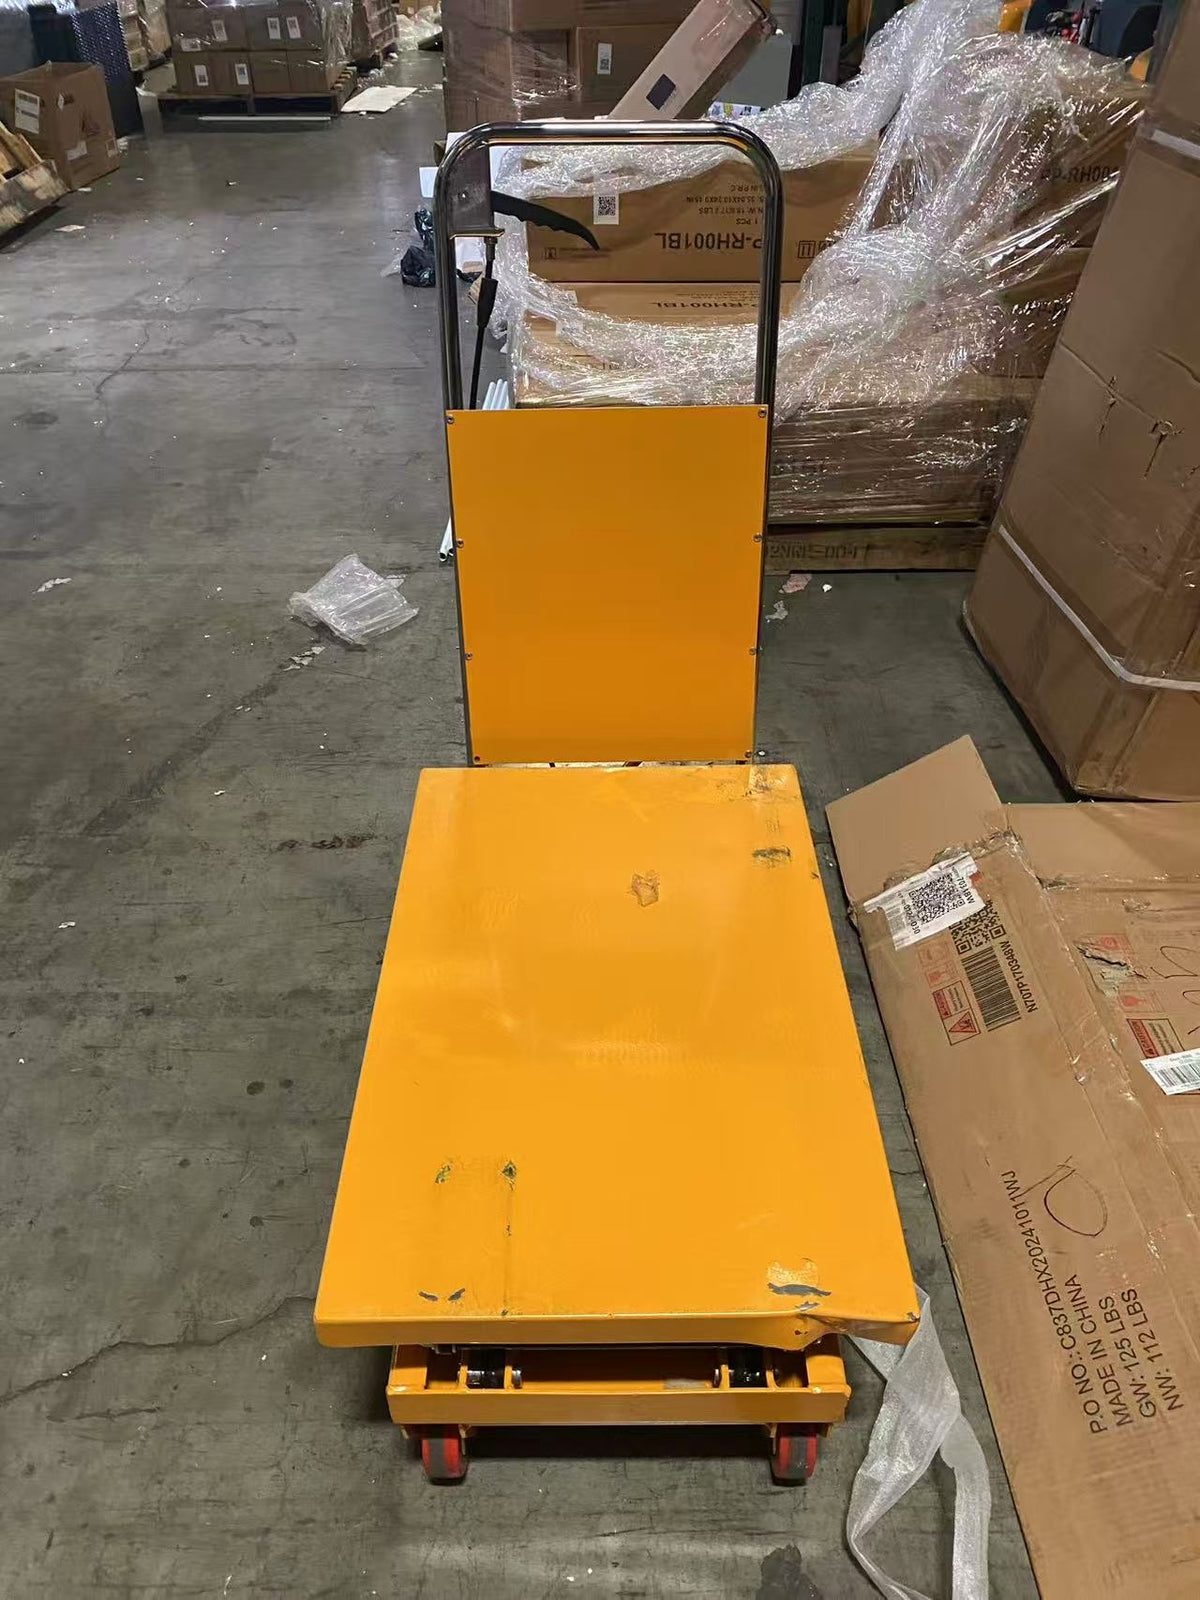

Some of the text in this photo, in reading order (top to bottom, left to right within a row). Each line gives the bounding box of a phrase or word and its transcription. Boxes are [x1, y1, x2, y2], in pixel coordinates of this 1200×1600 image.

[735, 217, 751, 225] PCS
[1000, 940, 1038, 1013] N707P170348W
[1001, 1170, 1076, 1350] C837DHX20241011WJ
[1064, 1274, 1134, 1427] MADE IN CHINA
[1098, 1296, 1157, 1418] GW: 125 LBS
[1121, 1288, 1185, 1411] NW: 112 LBS
[1083, 1399, 1108, 1434] P.O
